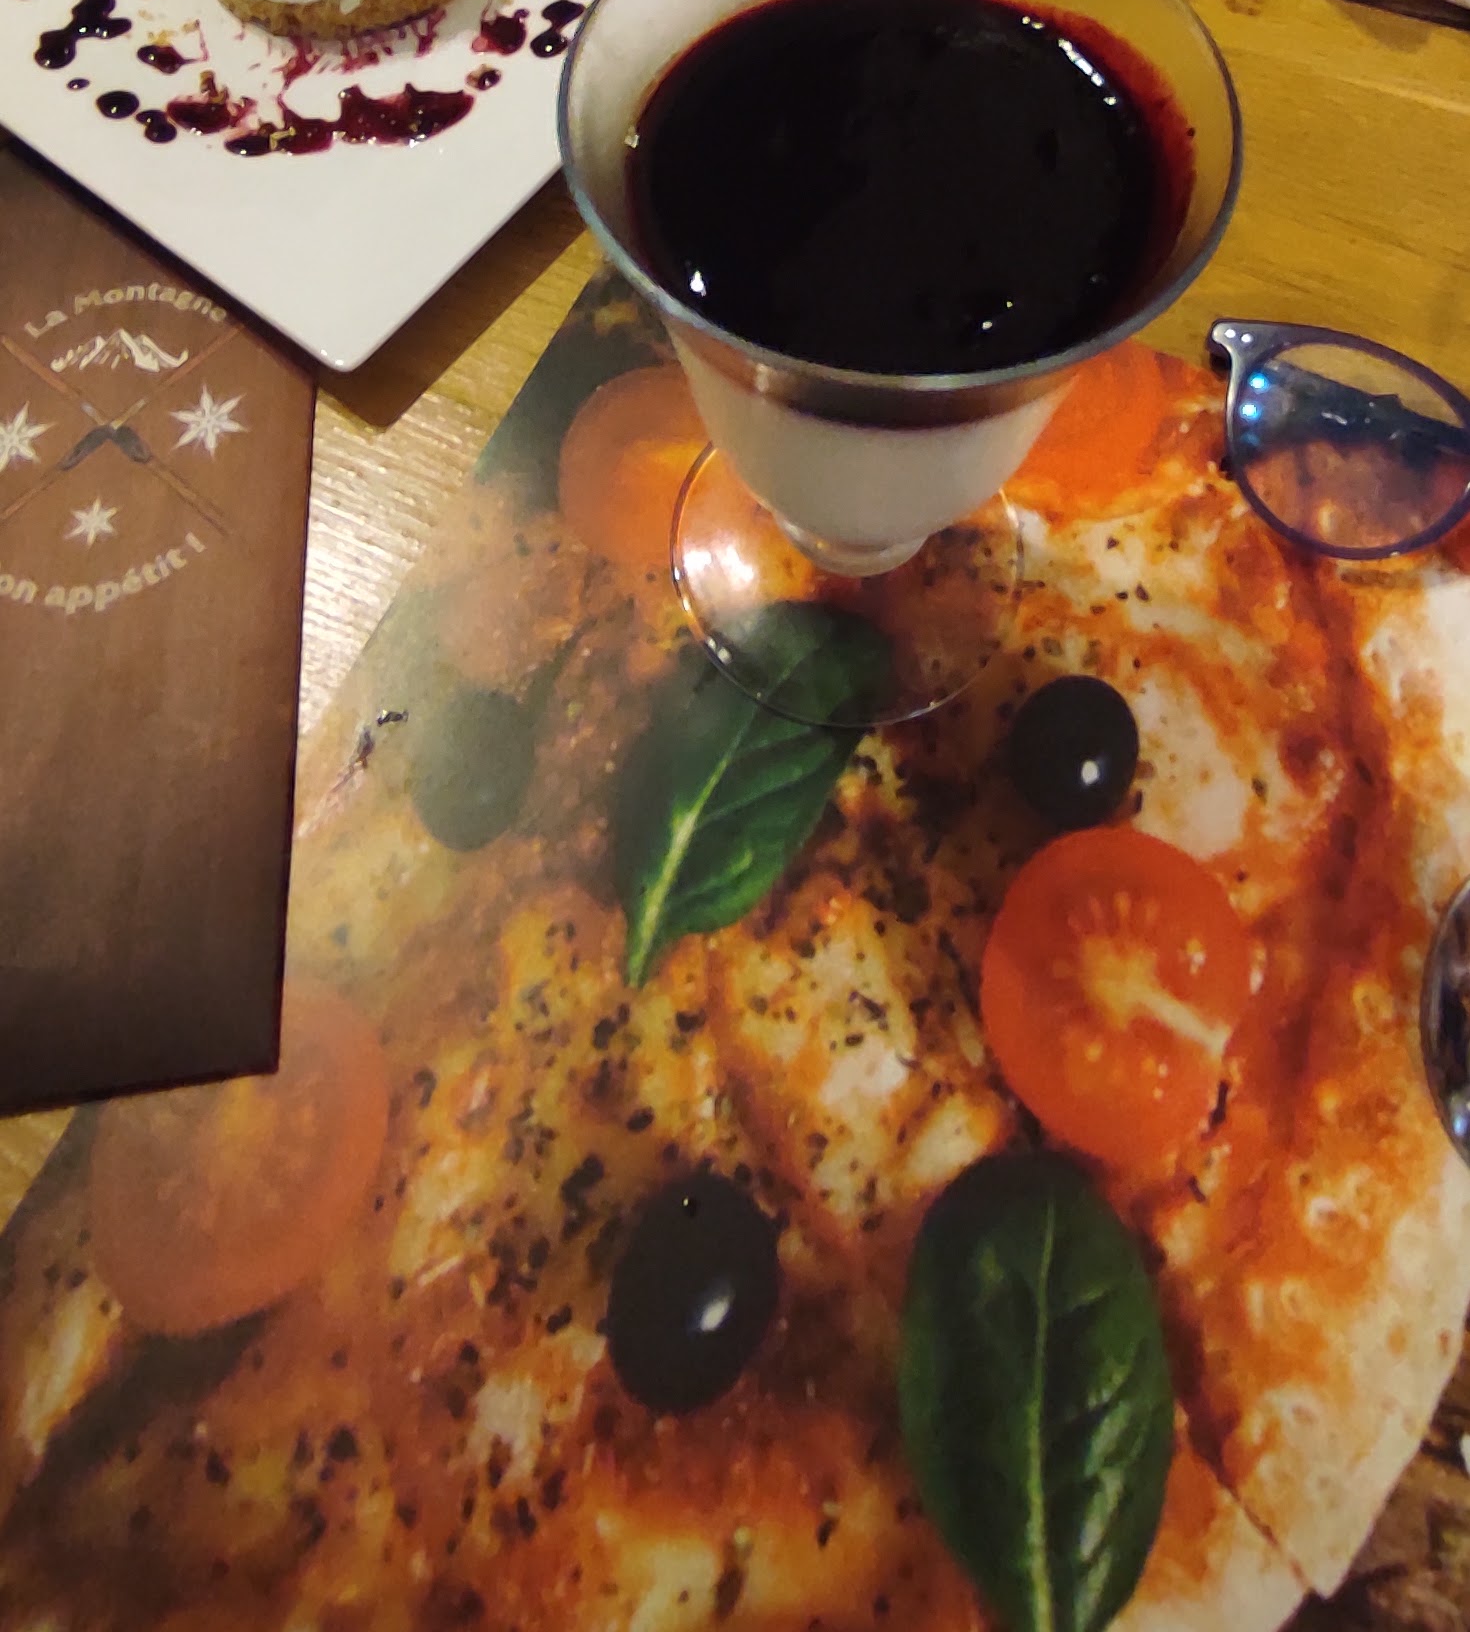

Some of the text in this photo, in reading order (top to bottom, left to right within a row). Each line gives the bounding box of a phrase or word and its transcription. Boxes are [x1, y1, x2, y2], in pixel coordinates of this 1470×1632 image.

[24, 282, 228, 339] La Montagne
[0, 573, 38, 605] on
